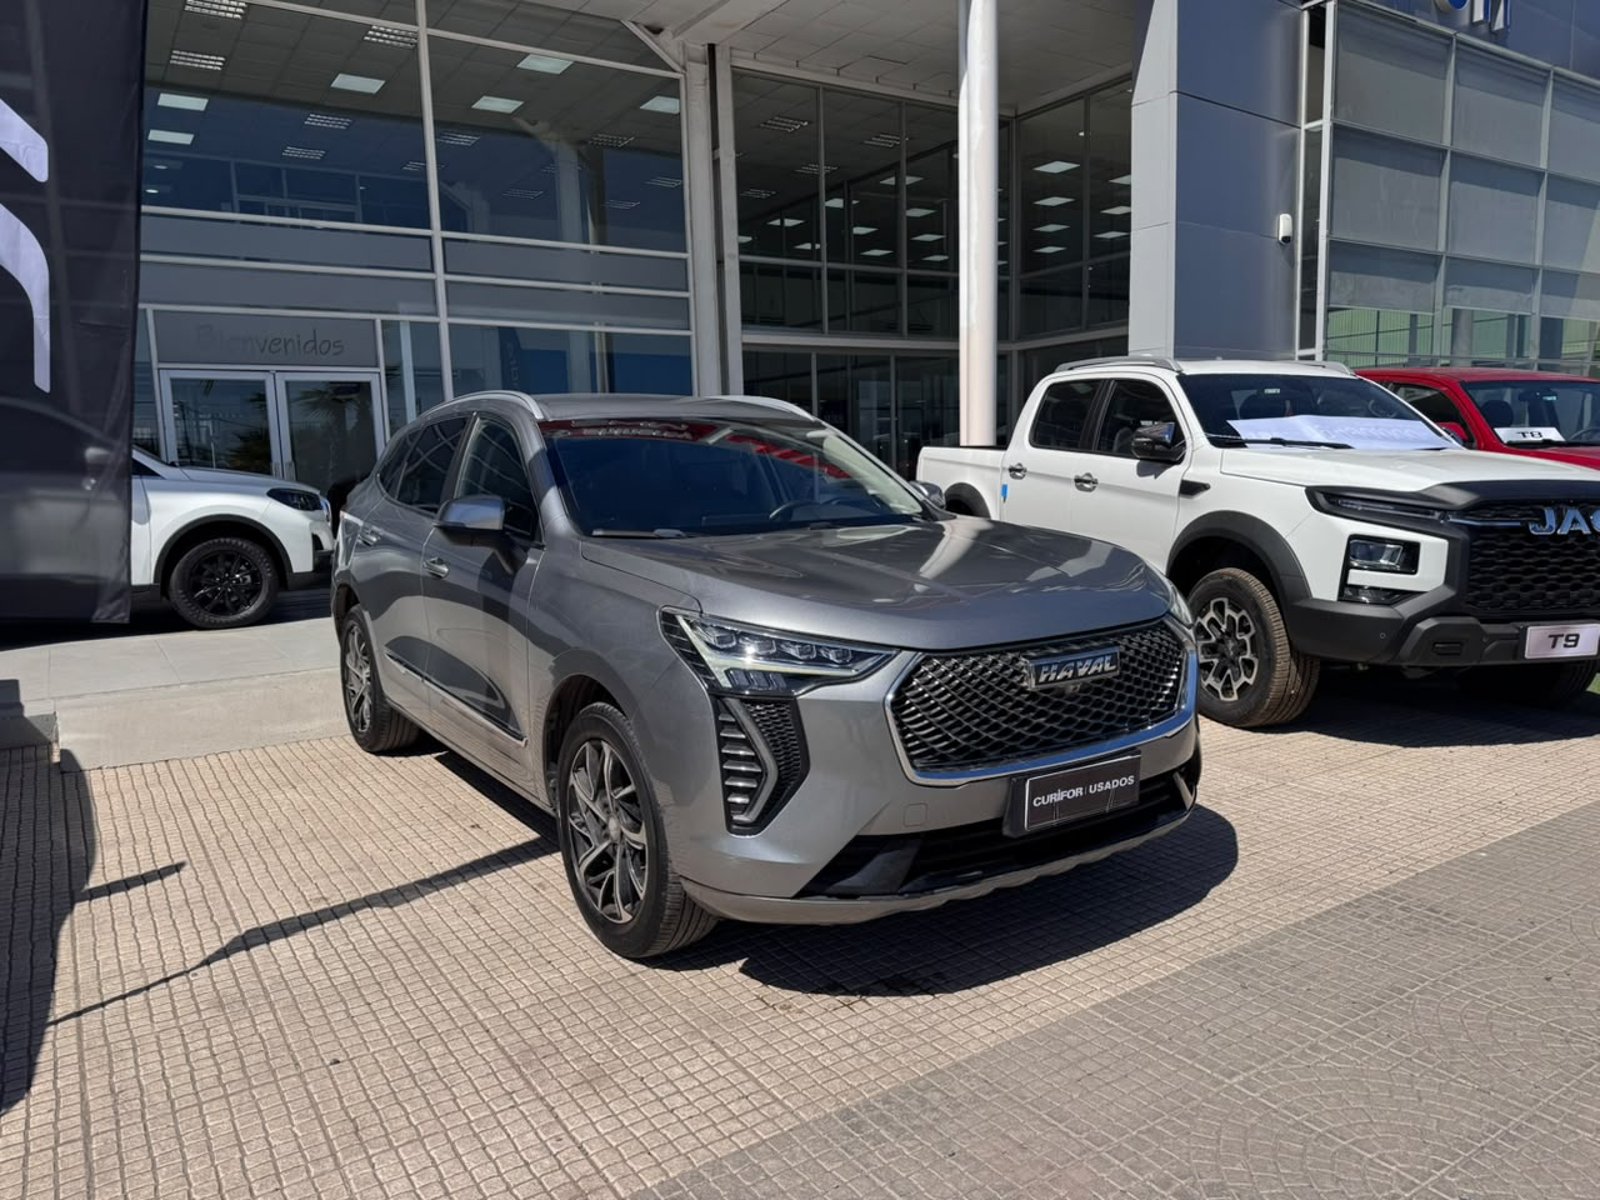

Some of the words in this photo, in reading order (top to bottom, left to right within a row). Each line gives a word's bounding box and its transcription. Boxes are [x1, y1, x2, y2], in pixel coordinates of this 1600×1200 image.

[1548, 632, 1581, 650] T9
[1038, 654, 1118, 683] HAVAL
[1089, 774, 1135, 794] USADOS
